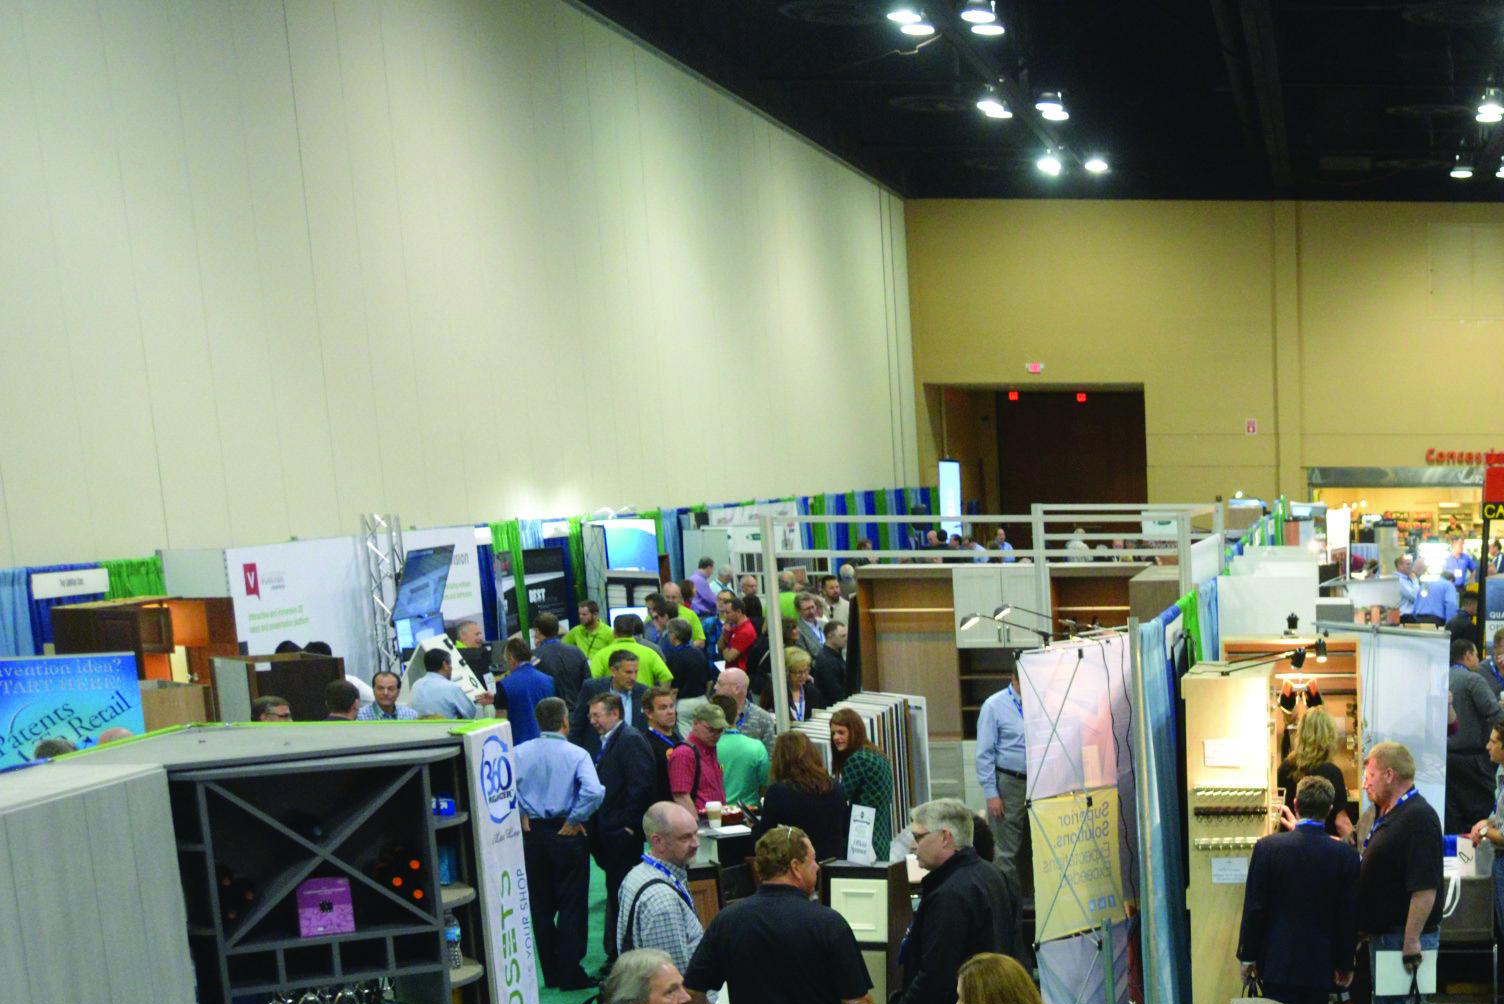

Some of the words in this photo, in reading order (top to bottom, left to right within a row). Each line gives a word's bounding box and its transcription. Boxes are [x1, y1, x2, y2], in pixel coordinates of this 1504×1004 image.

[0, 661, 71, 677] vention
[76, 658, 122, 674] idea?
[68, 690, 133, 737] Retail
[484, 756, 512, 795] 360
[516, 868, 529, 911] SHOP
